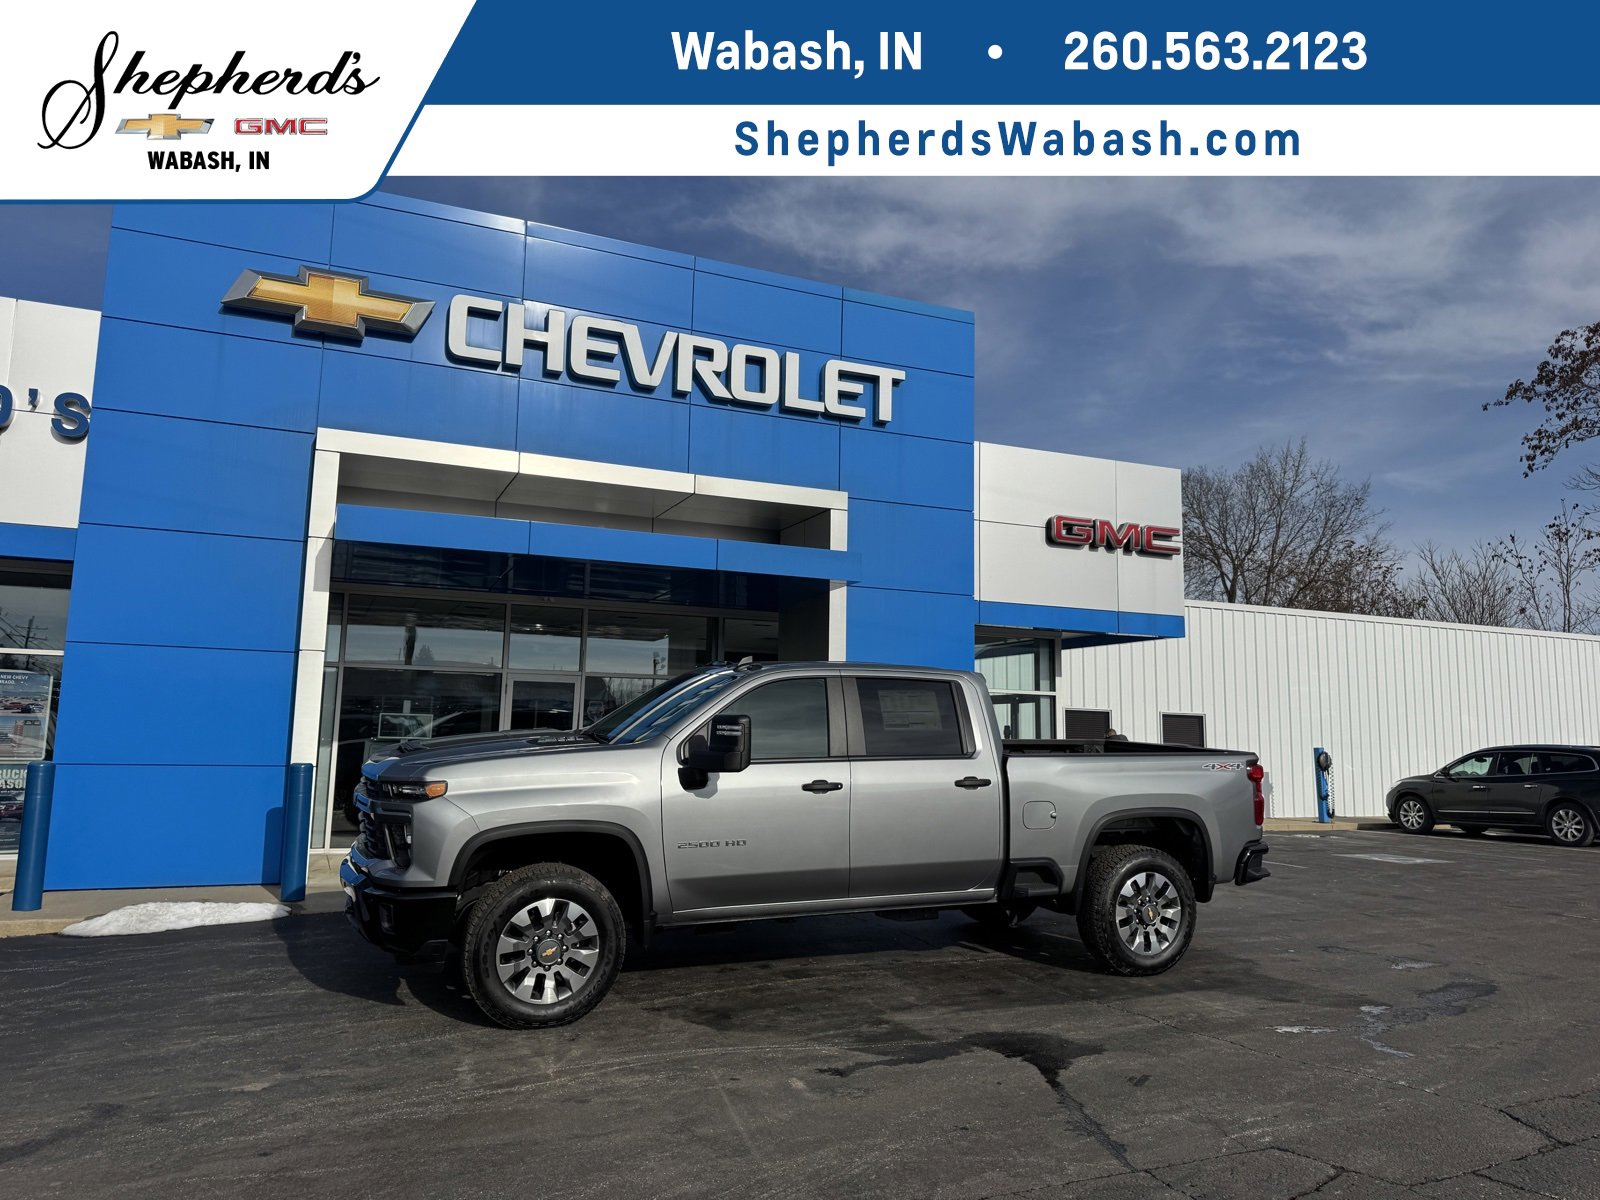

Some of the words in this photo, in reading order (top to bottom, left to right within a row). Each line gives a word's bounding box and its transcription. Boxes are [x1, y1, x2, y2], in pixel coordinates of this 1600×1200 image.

[446, 293, 907, 424] CHEVROLET
[1048, 514, 1182, 556] GMC
[0, 768, 27, 779] UCK
[677, 840, 720, 849] 2500
[725, 839, 747, 847] HD
